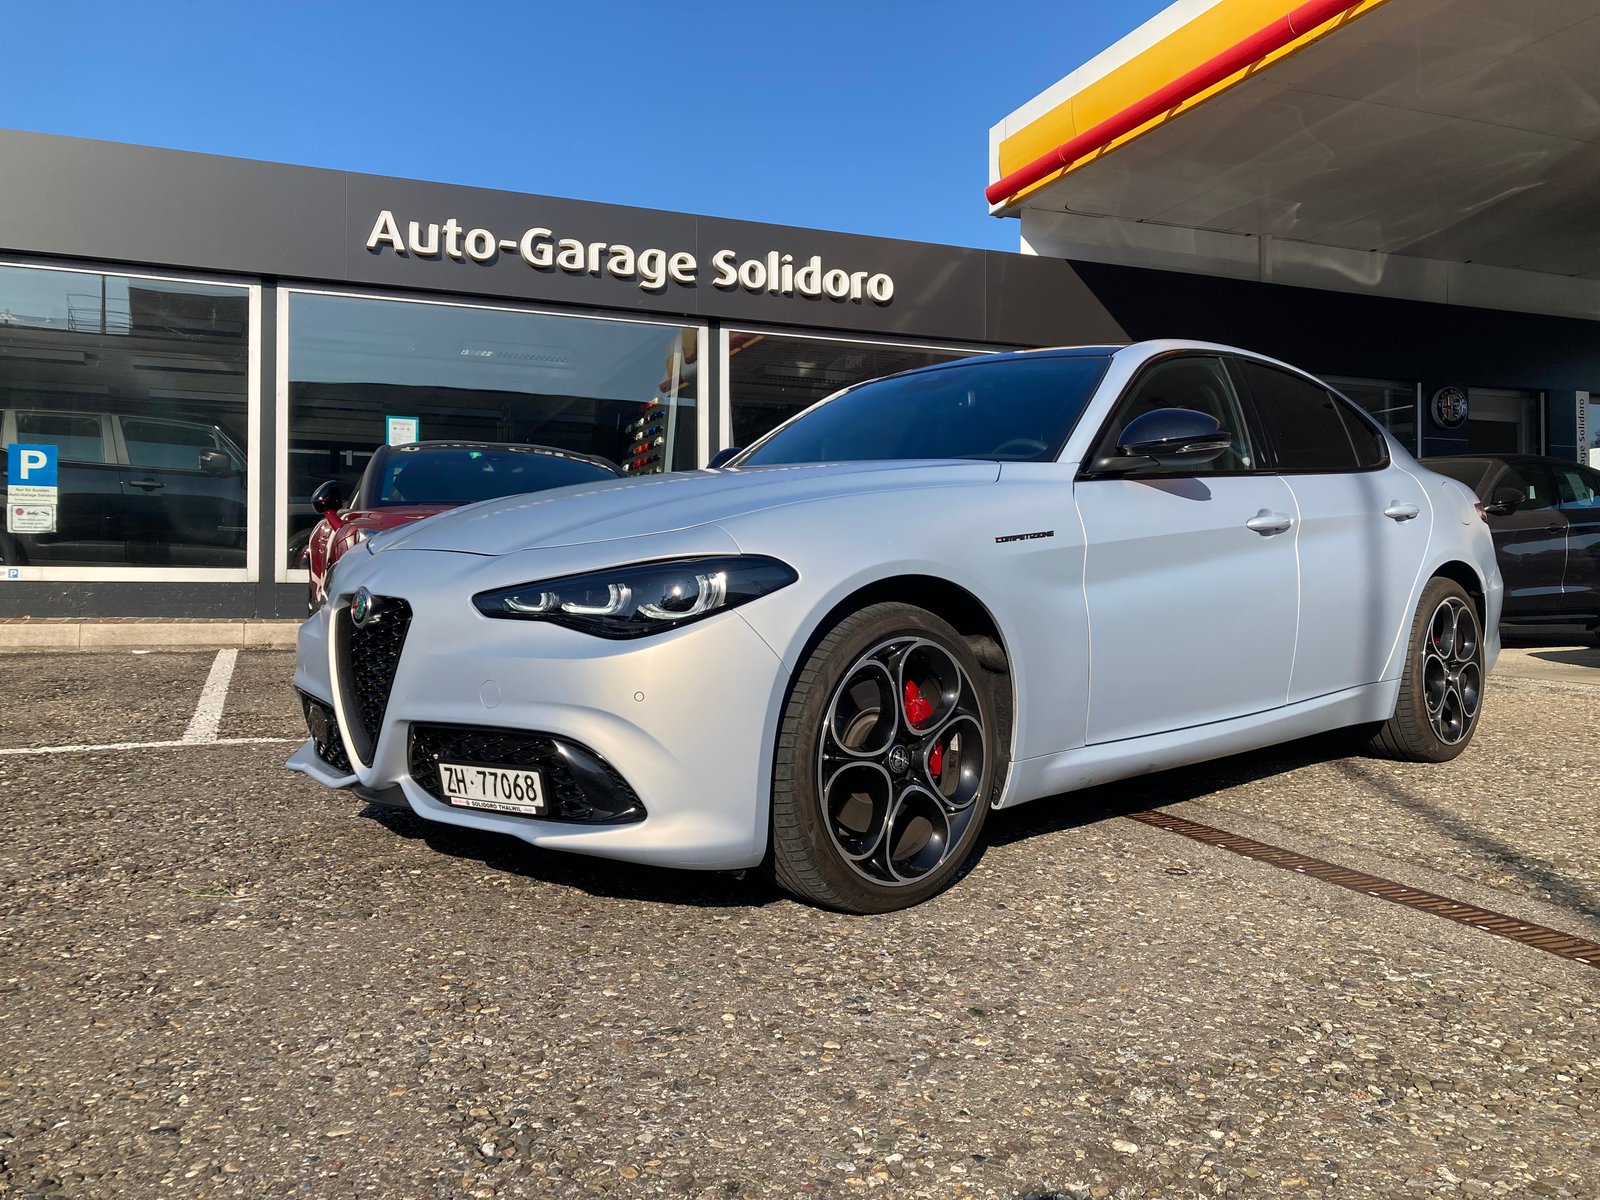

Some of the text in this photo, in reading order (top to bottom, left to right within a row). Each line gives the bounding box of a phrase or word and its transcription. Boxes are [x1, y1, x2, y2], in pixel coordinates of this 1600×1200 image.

[366, 210, 894, 301] Auto-Garage Solidoro
[1578, 398, 1586, 442] Solidoro
[20, 449, 47, 480] P
[471, 801, 497, 809] SOLIDORO
[499, 804, 522, 812] THALWIL
